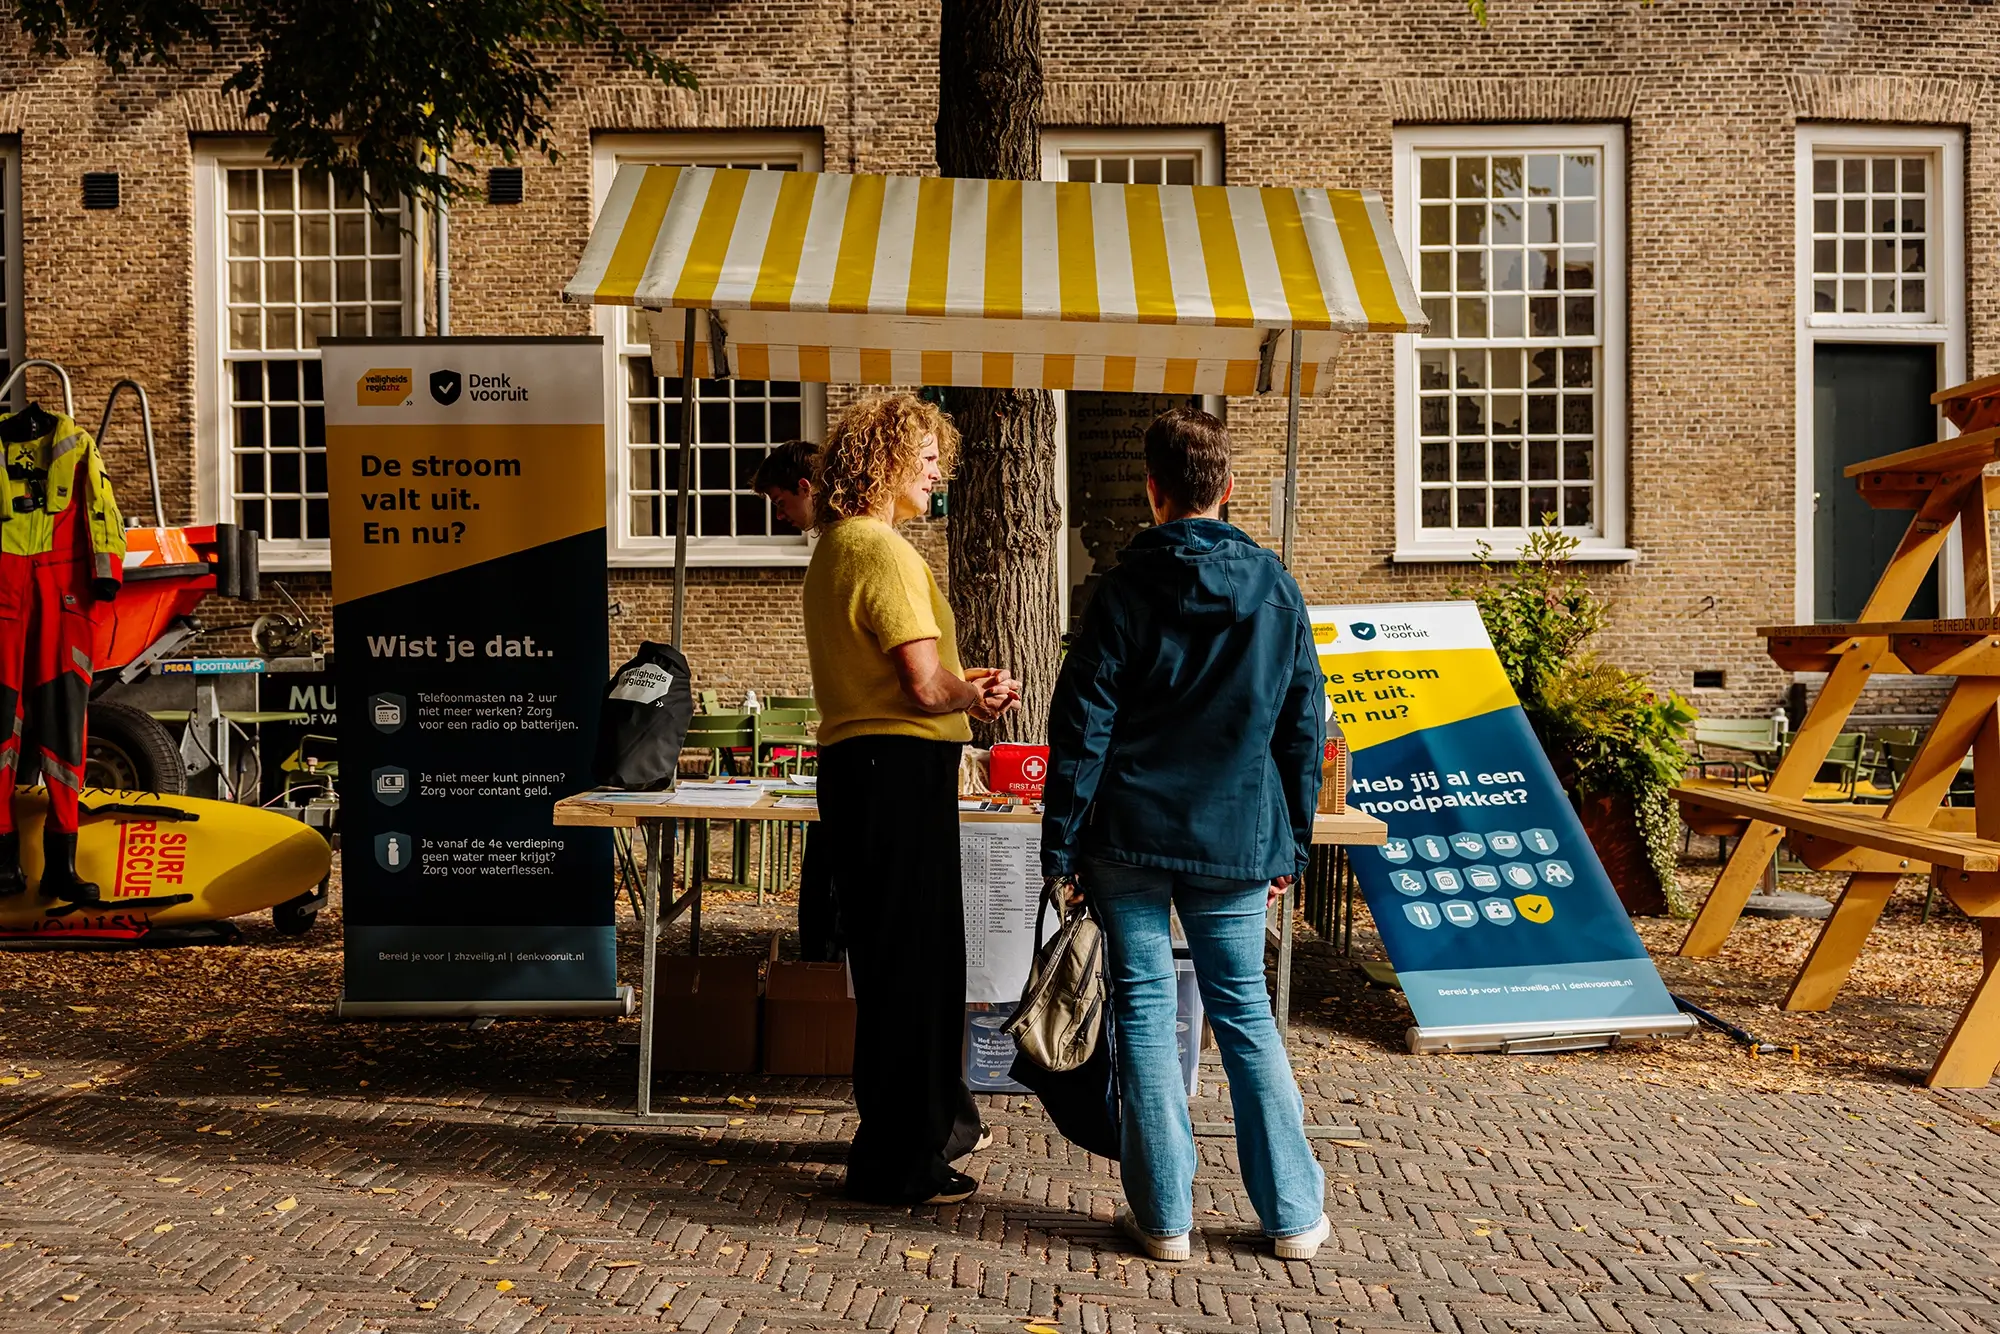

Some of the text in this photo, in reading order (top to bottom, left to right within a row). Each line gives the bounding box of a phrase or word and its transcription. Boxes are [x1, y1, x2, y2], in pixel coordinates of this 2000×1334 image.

[365, 375, 408, 384] veiligheids
[469, 373, 511, 388] Denk
[365, 384, 400, 392] regiozhz
[470, 387, 529, 402] vooruit
[361, 455, 521, 477] De stroom
[361, 488, 480, 510] valt uit.
[363, 521, 466, 544] En nu?
[1380, 623, 1413, 632] Denk
[1933, 619, 1975, 632] BETREDEN
[1978, 617, 1990, 631] OP
[1384, 629, 1429, 638] vooruit
[367, 635, 554, 663] Wist je dat..
[165, 660, 262, 673] PEGA BOOTTRAILERS
[1352, 668, 1440, 683] stroom
[417, 693, 557, 703] Telefoonmasten na 2 uur
[1329, 685, 1415, 704] alt uit.
[418, 706, 552, 719] niet meer werken? Zorg
[1365, 705, 1408, 721] nu?
[419, 719, 579, 732] voor een radio op batterijen.
[420, 772, 566, 786] Je niet meer kunt pinnen?
[1352, 776, 1404, 794] Heb
[1410, 771, 1440, 793] jij
[1446, 771, 1470, 786] al
[1478, 770, 1526, 785] een
[421, 786, 551, 799] Zorg voor contant geld.
[1360, 789, 1528, 814] noodpakket?
[421, 838, 565, 851] Je vanaf de 4e verdieping
[123, 820, 156, 897] RESCUE
[156, 833, 187, 885] SURF
[422, 852, 556, 865] geen water meer krijgt?
[423, 865, 554, 877] Zorg voor waterflessen.
[379, 952, 408, 962] Bereid
[411, 952, 421, 964] je
[424, 954, 444, 962] voor
[454, 951, 507, 963] zhzveilig.nl
[516, 952, 585, 962] denkvooruit.nl
[1438, 987, 1467, 996] Bereid
[1469, 987, 1479, 995] je
[1481, 986, 1501, 994] voor
[1511, 983, 1560, 993] zhzveilig.nl
[1569, 979, 1633, 990] denkvooruit.nl
